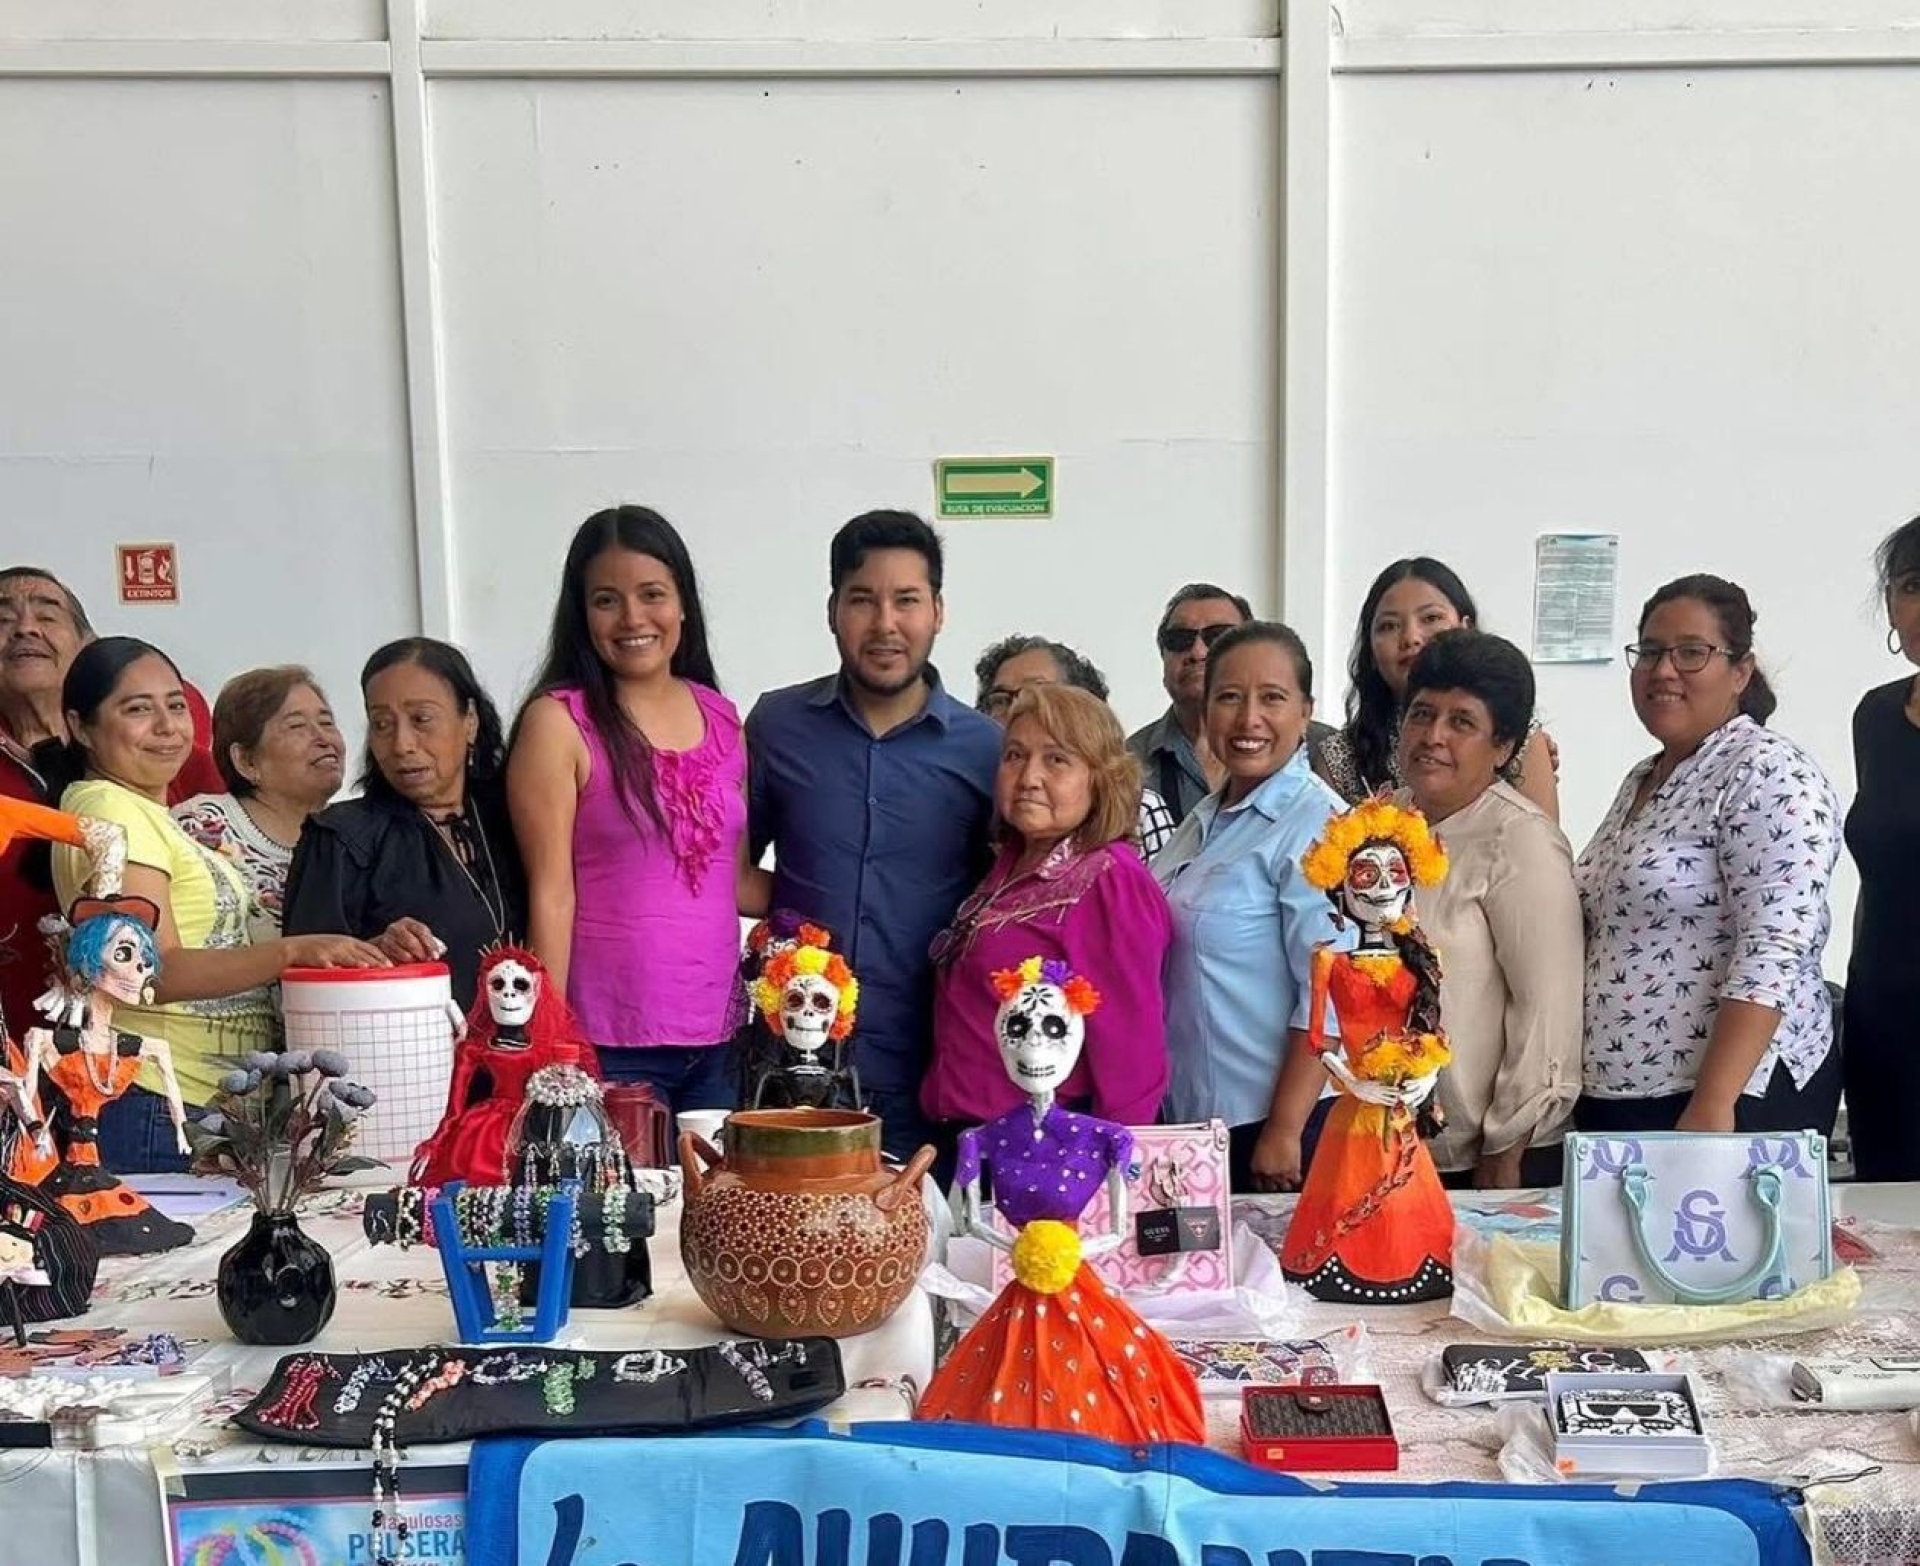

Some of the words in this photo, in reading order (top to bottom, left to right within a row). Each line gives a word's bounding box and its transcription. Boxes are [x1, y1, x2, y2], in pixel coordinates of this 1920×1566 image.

[971, 504, 984, 514] DE
[127, 588, 172, 598] EXTINTOR
[348, 1529, 466, 1560] PULSERA
